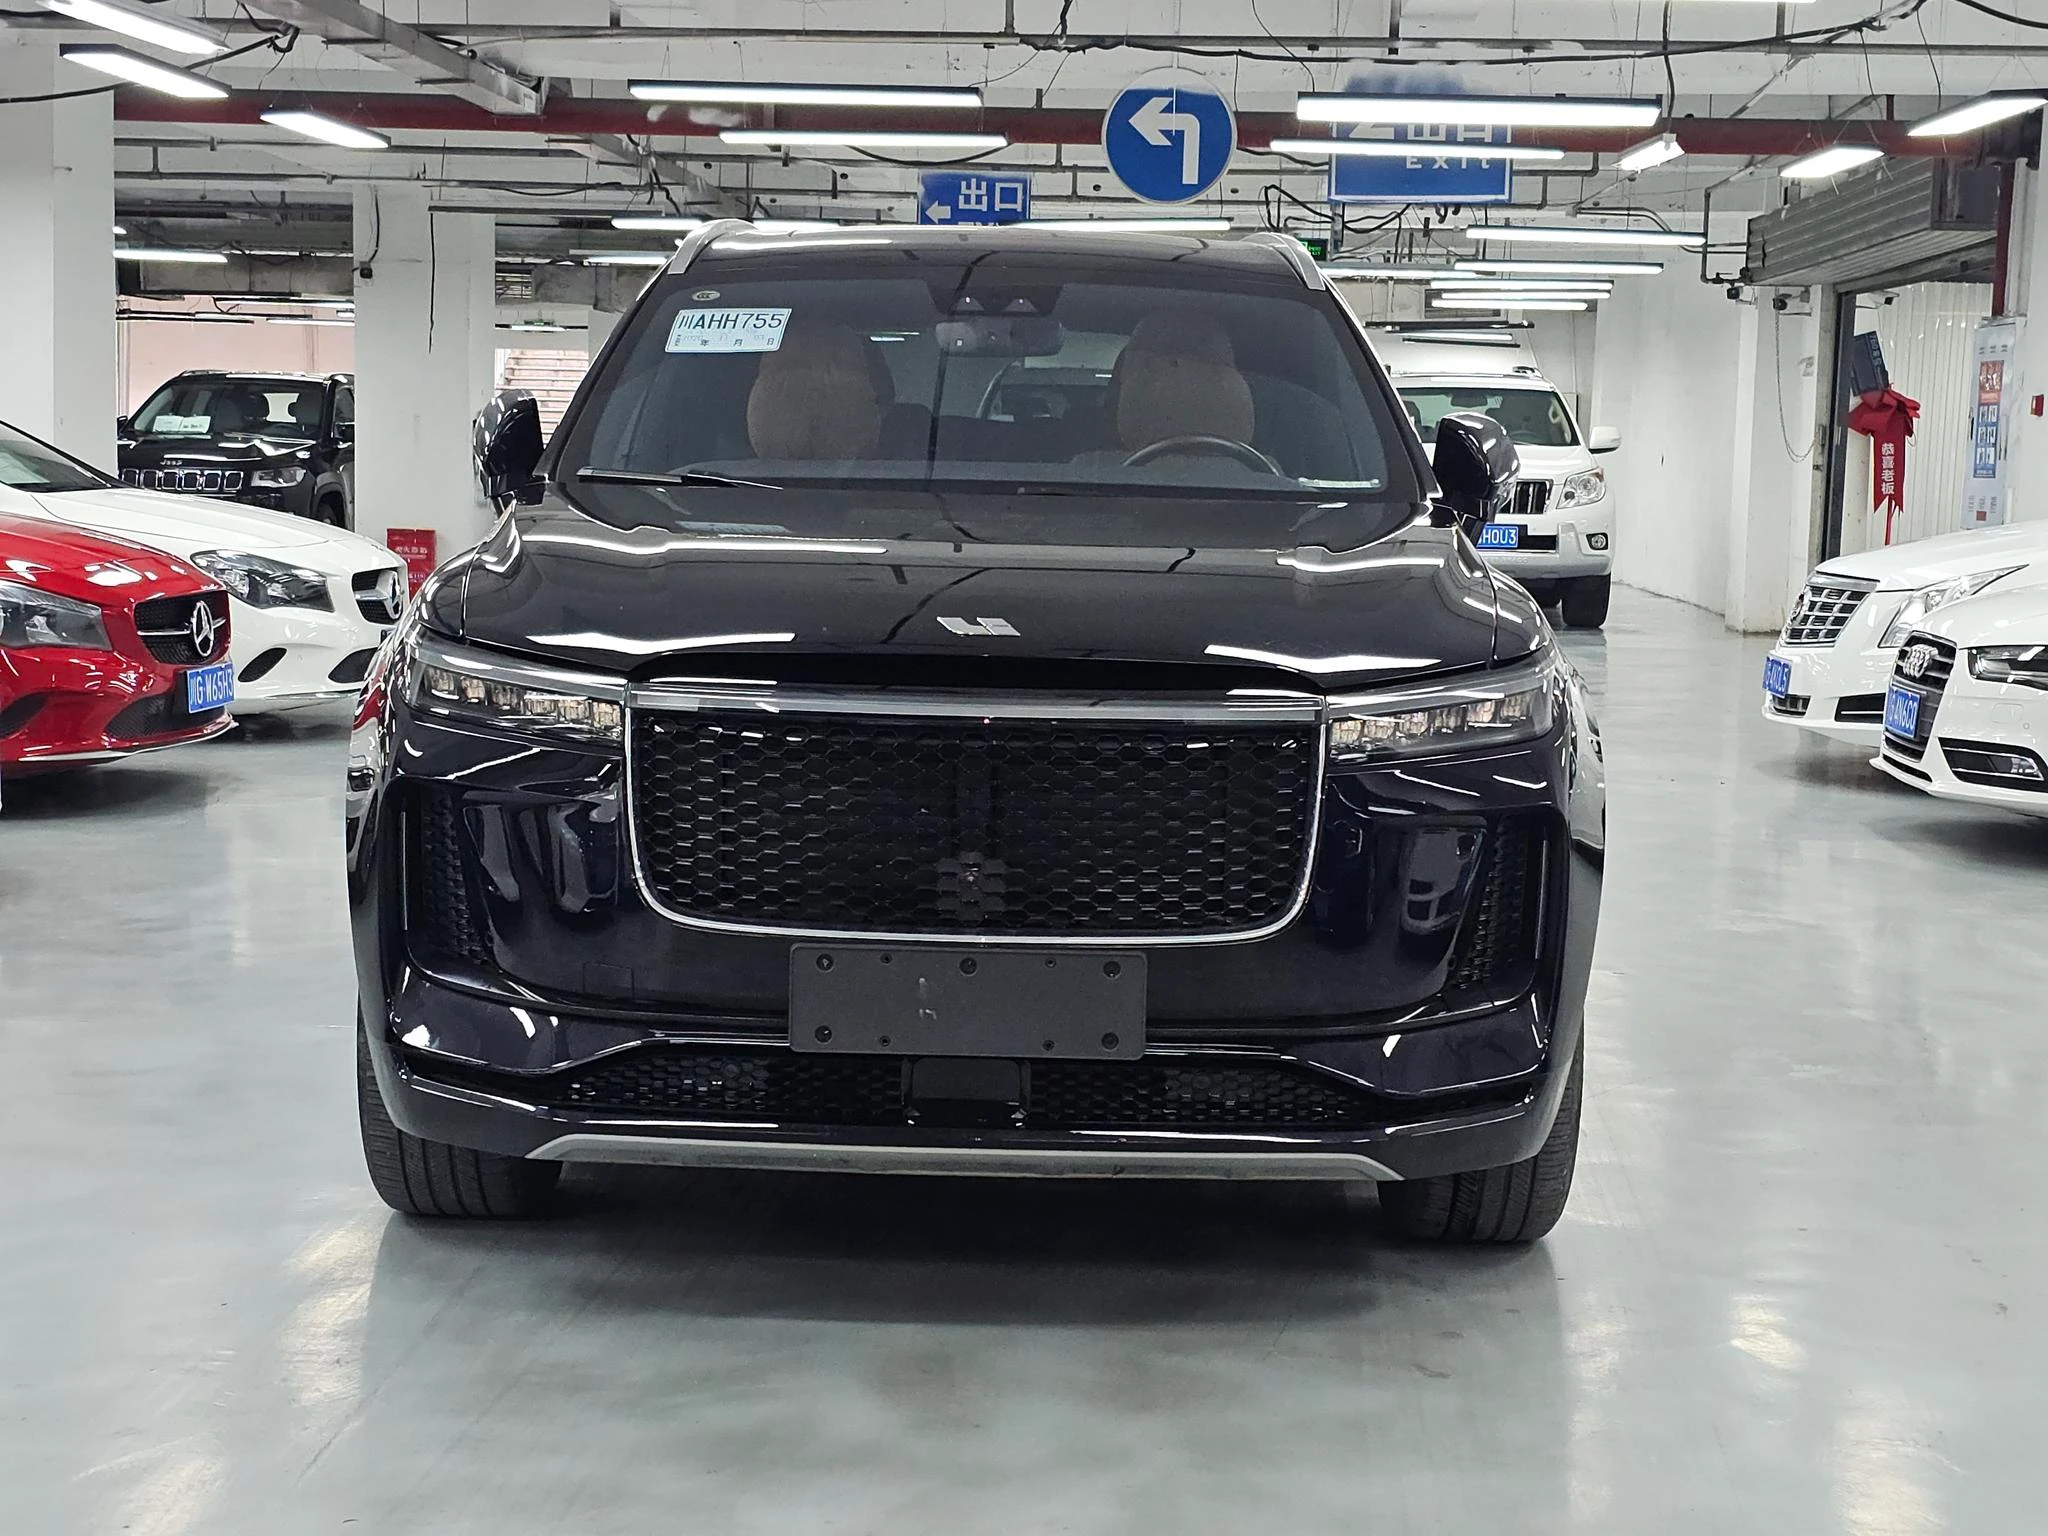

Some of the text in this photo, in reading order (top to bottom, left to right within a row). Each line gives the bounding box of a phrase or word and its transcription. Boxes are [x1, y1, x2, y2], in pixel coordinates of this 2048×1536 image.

[959, 178, 1023, 212] 出口
[678, 313, 784, 329] 川AHH755
[1881, 442, 1895, 495] 恭喜老板
[1479, 528, 1516, 544] H0U3
